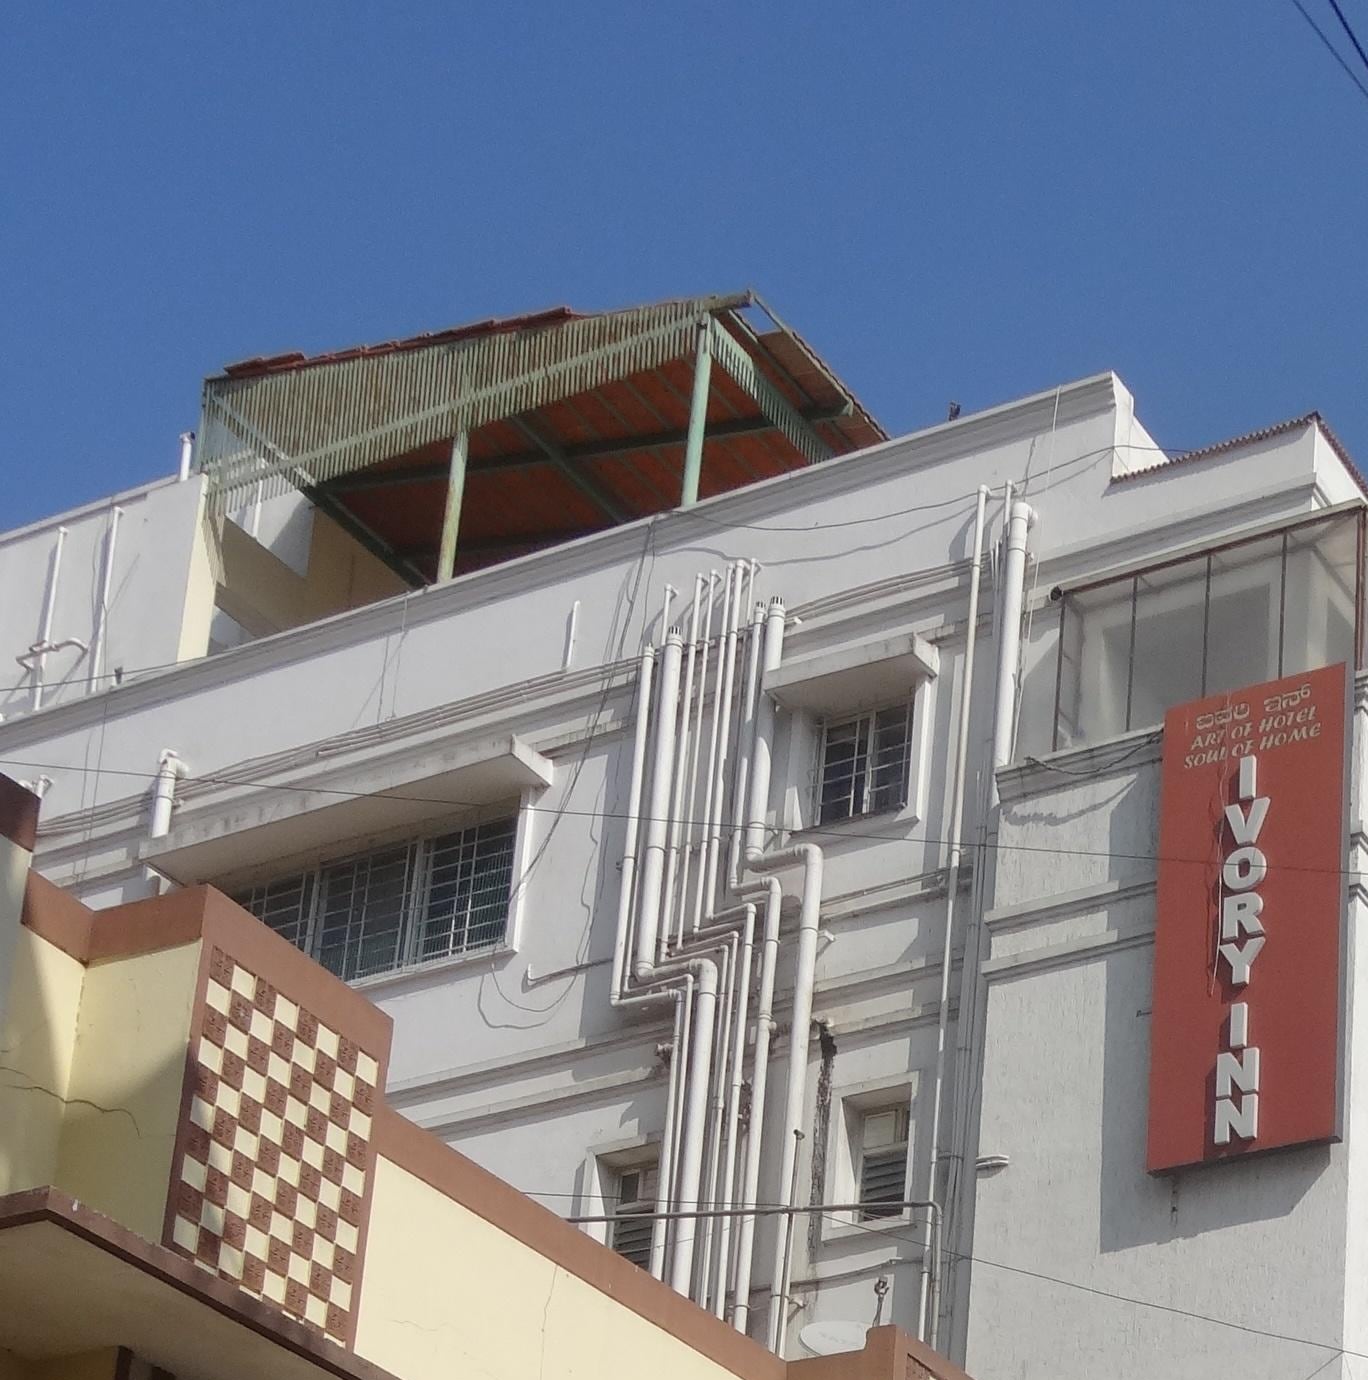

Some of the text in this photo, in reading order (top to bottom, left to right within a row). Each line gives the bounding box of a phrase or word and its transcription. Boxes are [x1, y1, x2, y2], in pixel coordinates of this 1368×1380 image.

[1184, 723, 1321, 769] SOUL OF HOME
[1190, 705, 1317, 751] ART OF HOTEL
[1214, 754, 1272, 1146] IVORY INN
